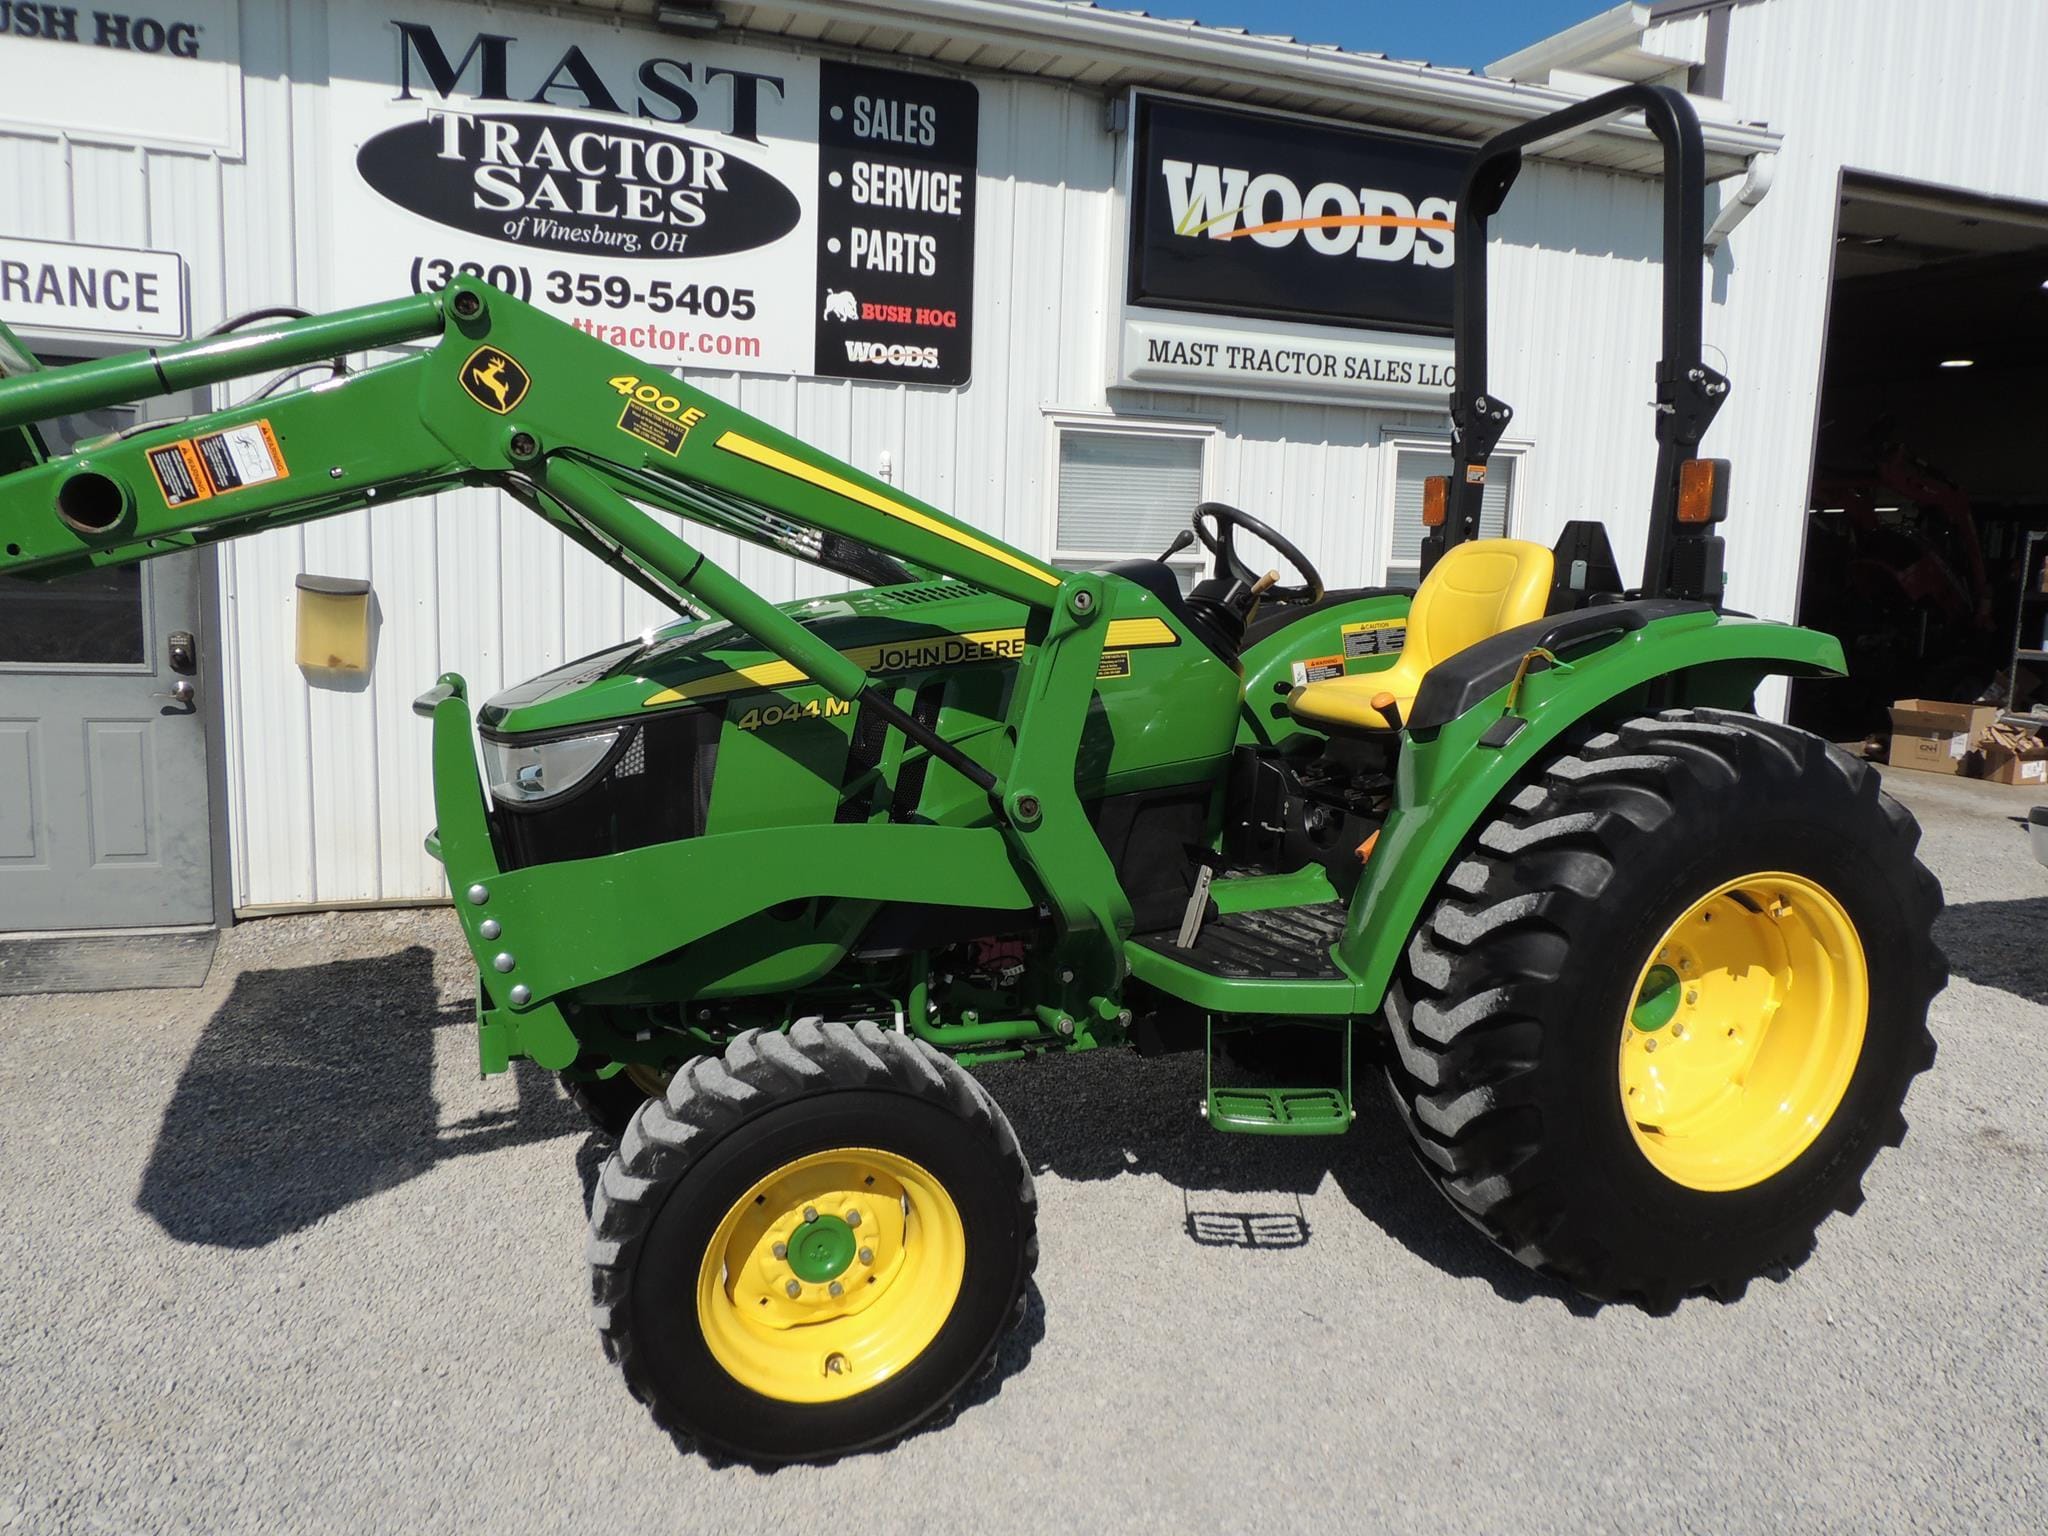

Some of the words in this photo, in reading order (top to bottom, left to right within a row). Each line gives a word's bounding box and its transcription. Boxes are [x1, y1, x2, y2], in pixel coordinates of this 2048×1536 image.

[93, 11, 200, 59] HOG
[391, 20, 785, 147] MAST
[853, 95, 936, 147] SALES
[427, 108, 728, 192] TRACTOR
[473, 165, 706, 227] SALES
[851, 161, 963, 215] SERVICE
[503, 216, 530, 241] of
[532, 217, 642, 252] Winesburg,
[650, 231, 689, 253] OH
[1162, 158, 1457, 269] WOODS
[850, 227, 937, 276] PARTS
[0, 259, 160, 313] RANCE
[546, 270, 756, 321] 359-5405
[861, 303, 912, 324] BUSH
[915, 306, 957, 328] HOG
[845, 340, 939, 369] WOODS
[1147, 339, 1219, 367] MAST
[1226, 345, 1338, 378] TRACTOR
[1343, 356, 1413, 384] SALES
[607, 376, 708, 427] 400E
[187, 456, 205, 493] WARNING
[1365, 622, 1389, 630] CAUTION
[870, 646, 940, 671] JOHN
[944, 638, 1025, 664] DEERE
